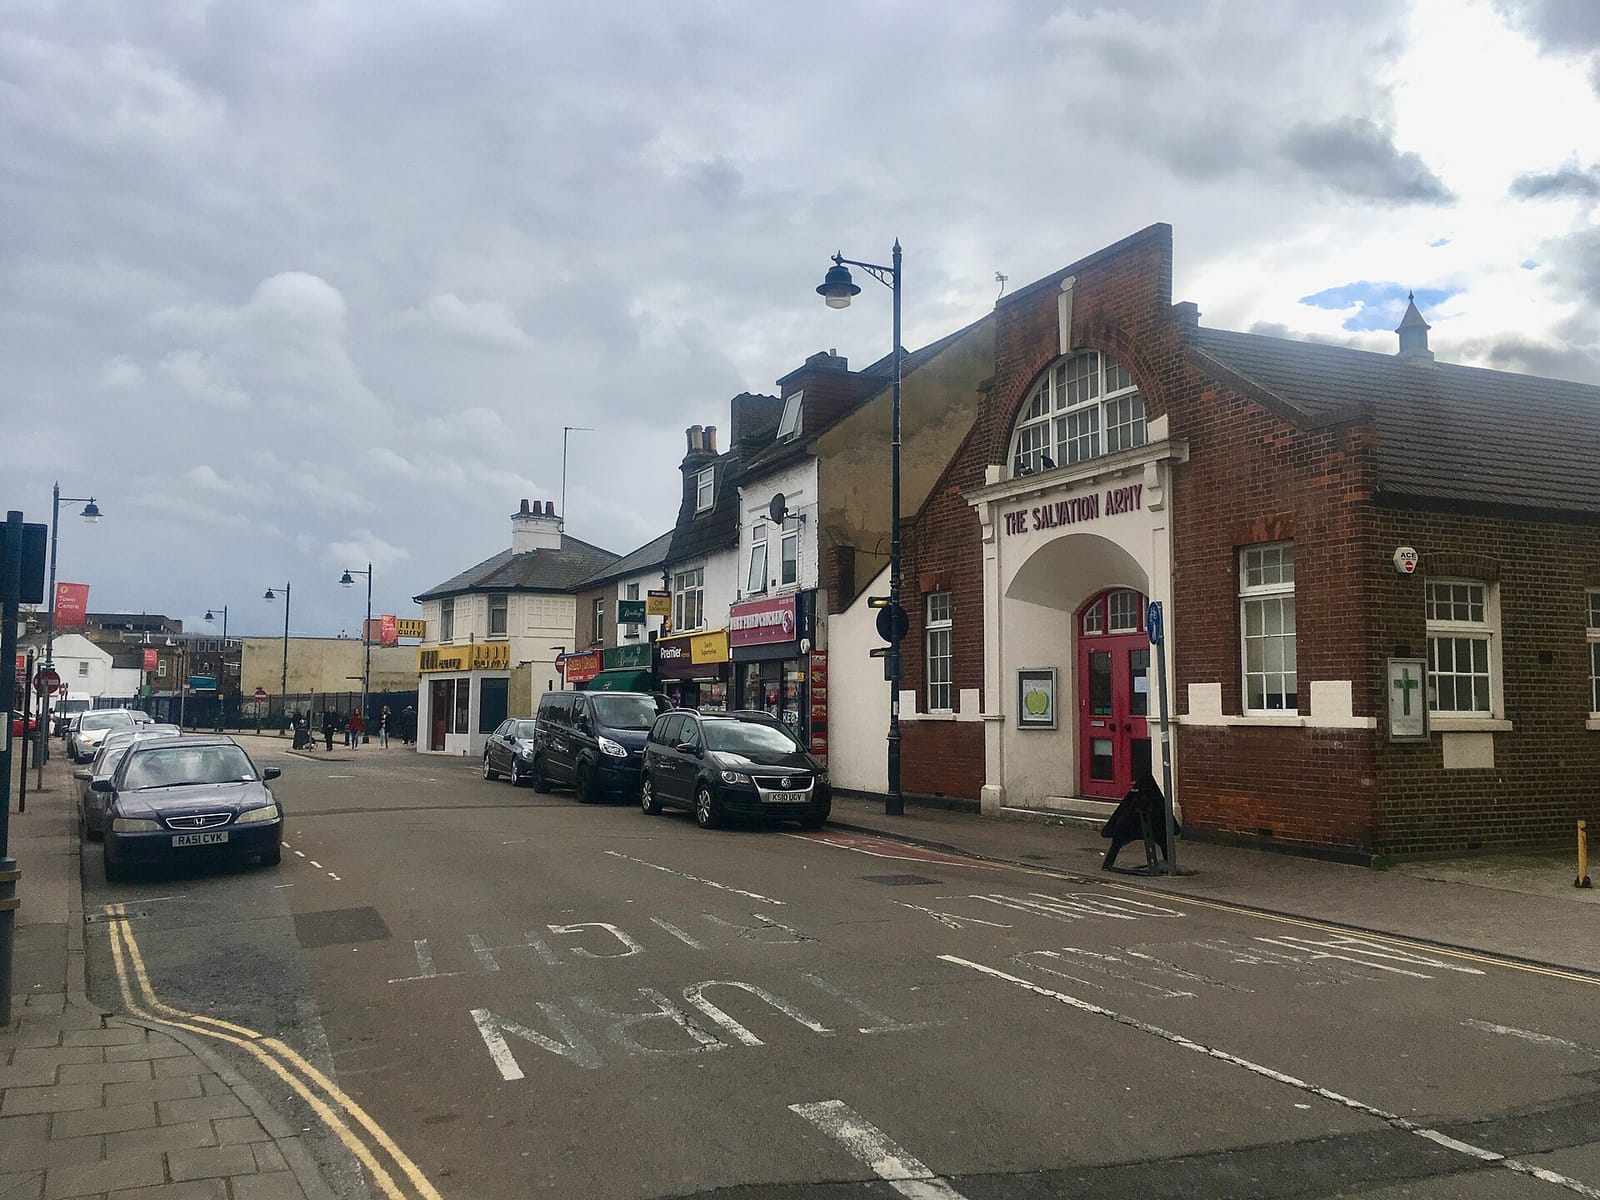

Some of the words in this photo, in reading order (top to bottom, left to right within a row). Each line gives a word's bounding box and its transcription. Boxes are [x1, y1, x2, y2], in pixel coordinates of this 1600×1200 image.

[1004, 509, 1028, 536] THE
[1032, 494, 1099, 531] SALVATION
[1105, 484, 1143, 516] ARMY
[57, 602, 80, 610] Centre
[398, 629, 422, 637] curry
[660, 646, 682, 659] Premier
[473, 659, 508, 670] curry
[178, 835, 201, 845] RA51
[203, 833, 222, 843] CVK
[470, 980, 945, 1081] TURN
